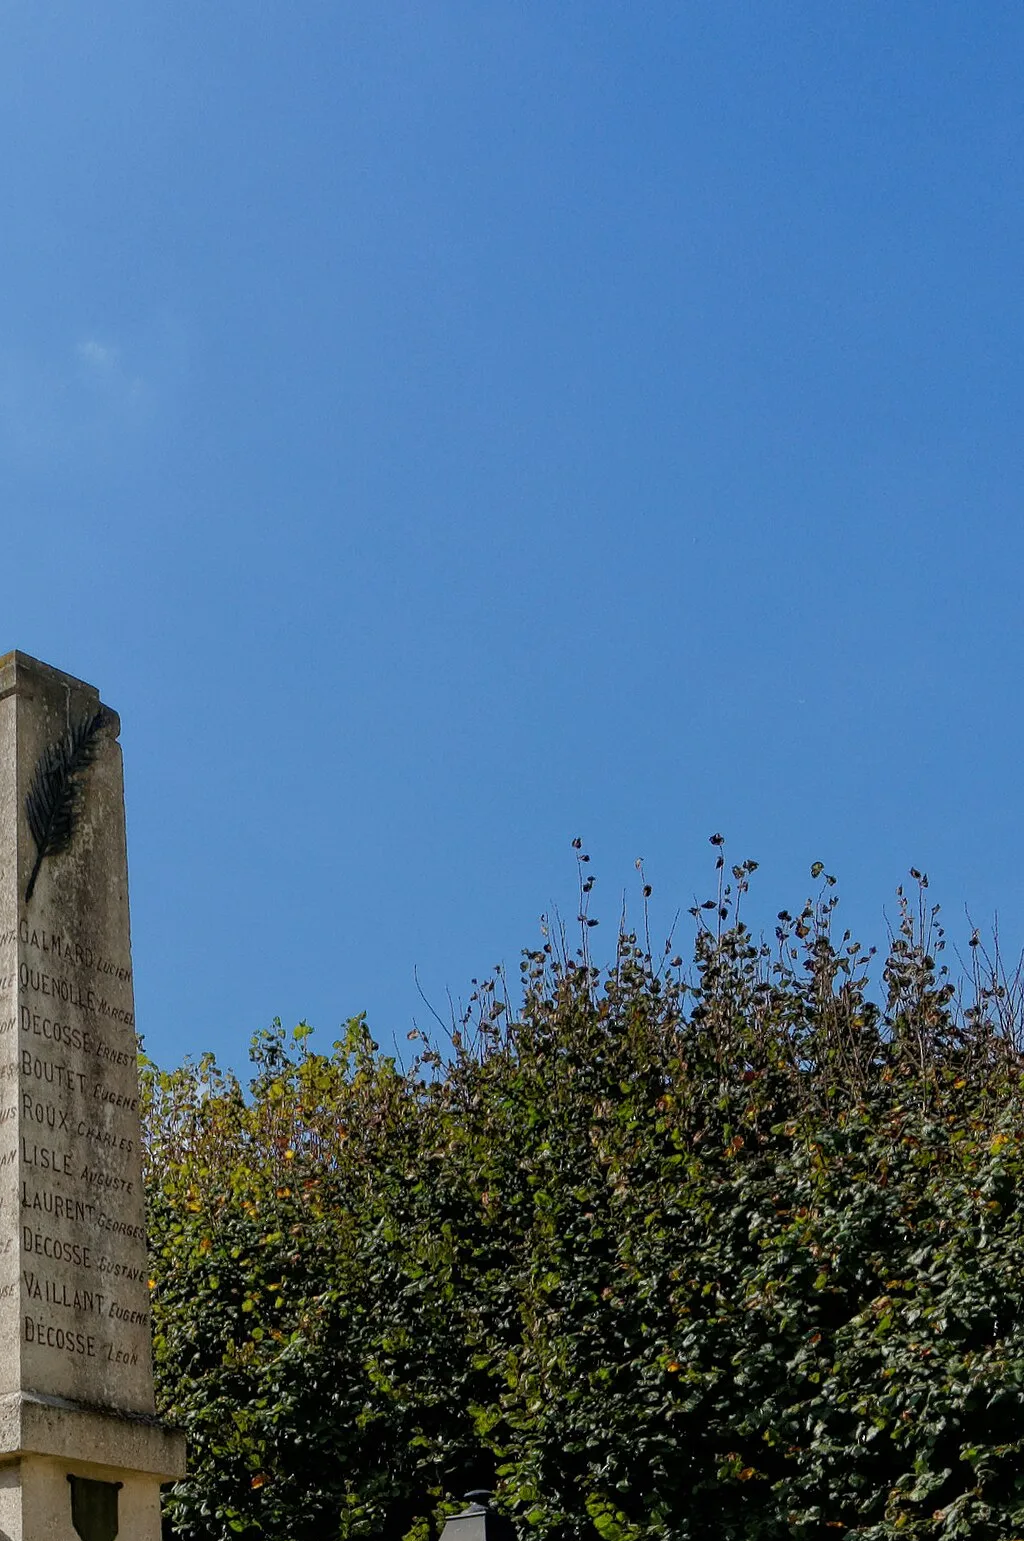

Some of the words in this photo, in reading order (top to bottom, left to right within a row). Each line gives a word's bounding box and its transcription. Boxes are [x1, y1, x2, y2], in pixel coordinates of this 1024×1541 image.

[20, 919, 93, 968] GALMARD
[97, 956, 131, 983] LUCIEN
[98, 997, 134, 1026] MARCEL
[21, 1049, 86, 1094] BOUTET
[97, 1042, 136, 1069] ERNEST
[22, 1093, 68, 1132] ROUX
[77, 1121, 134, 1153] CHARLES
[22, 1137, 72, 1176] LISLE
[81, 1165, 134, 1195] AUGUSTE
[22, 1180, 94, 1223] LAURENT
[97, 1212, 145, 1241] GEORGES
[23, 1269, 104, 1316] VAILLANT
[98, 1256, 146, 1284] GUSTAVE
